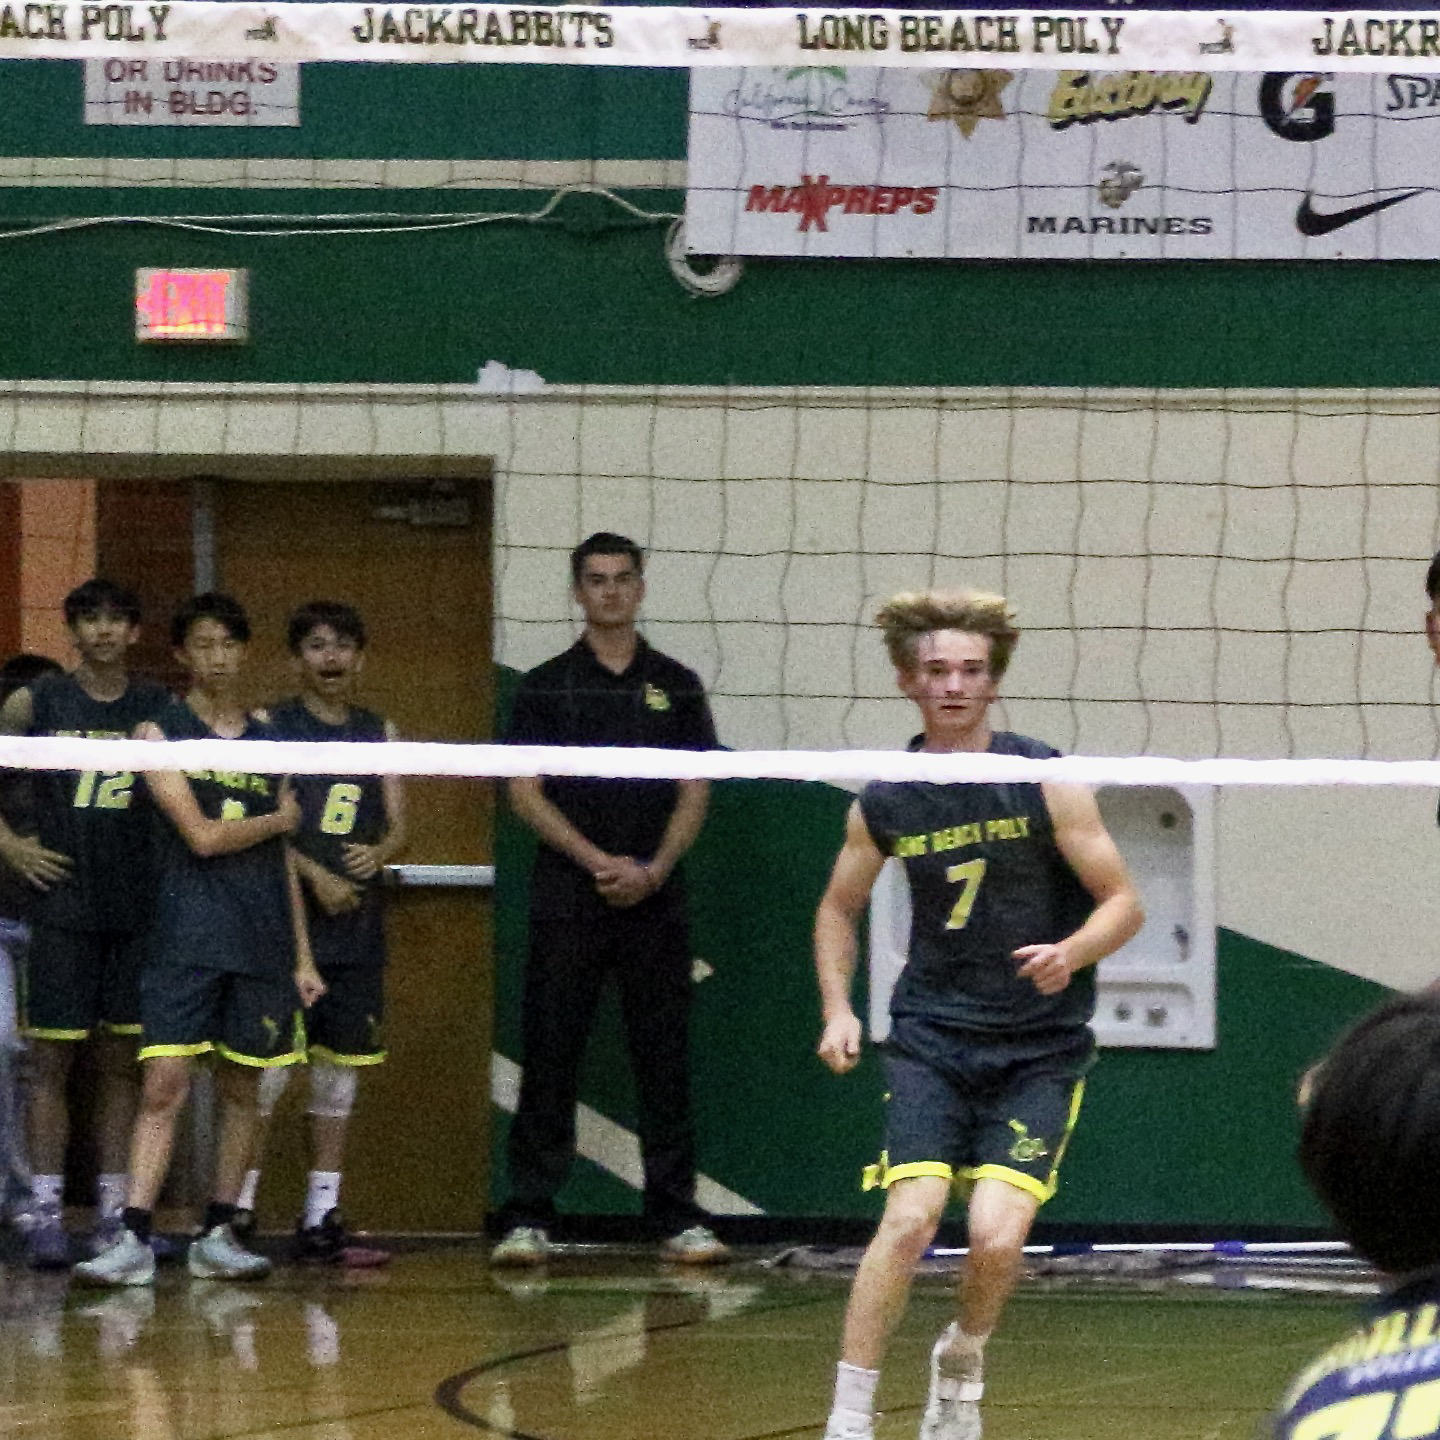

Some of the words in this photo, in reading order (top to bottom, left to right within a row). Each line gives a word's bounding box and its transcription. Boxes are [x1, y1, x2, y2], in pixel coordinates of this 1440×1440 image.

[80, 4, 171, 42] POLY
[351, 6, 616, 50] JACKRABBITS
[796, 14, 889, 51] LONG
[899, 15, 1021, 53] BEACH
[1033, 16, 1127, 54] POLY
[103, 59, 148, 84] OR
[124, 90, 153, 115] IN
[168, 90, 258, 116] BLDG.
[744, 175, 939, 232] MAXPREPS
[1026, 216, 1214, 236] MARINES
[319, 783, 363, 836] 6
[943, 857, 989, 932] 7
